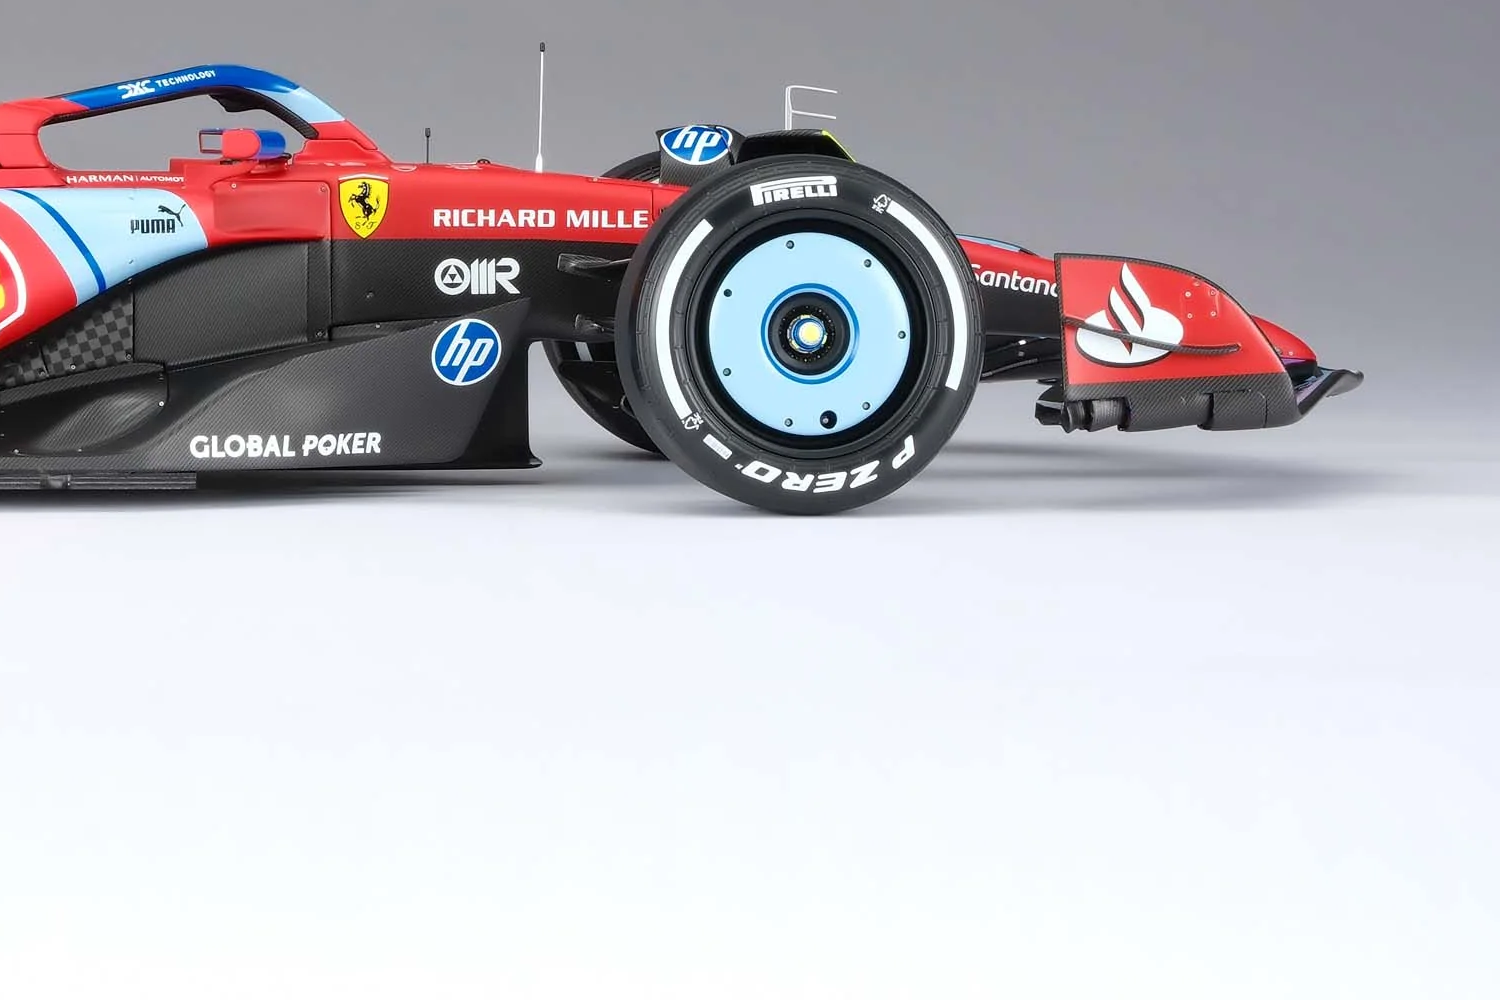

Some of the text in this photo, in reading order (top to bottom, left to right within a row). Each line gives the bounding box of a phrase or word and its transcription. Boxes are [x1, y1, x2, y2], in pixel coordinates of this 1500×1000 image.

[155, 69, 216, 88] TECHNOLOGY
[670, 125, 721, 163] hp
[66, 174, 134, 184] HARMAN
[750, 175, 838, 207] PIRELLI
[130, 218, 176, 234] PUMA
[433, 208, 649, 229] RICHARD MILLE
[970, 263, 1059, 298] Santan
[439, 319, 495, 384] hp
[189, 432, 382, 459] GLOBAL POKER
[740, 434, 915, 494] P ZERO
